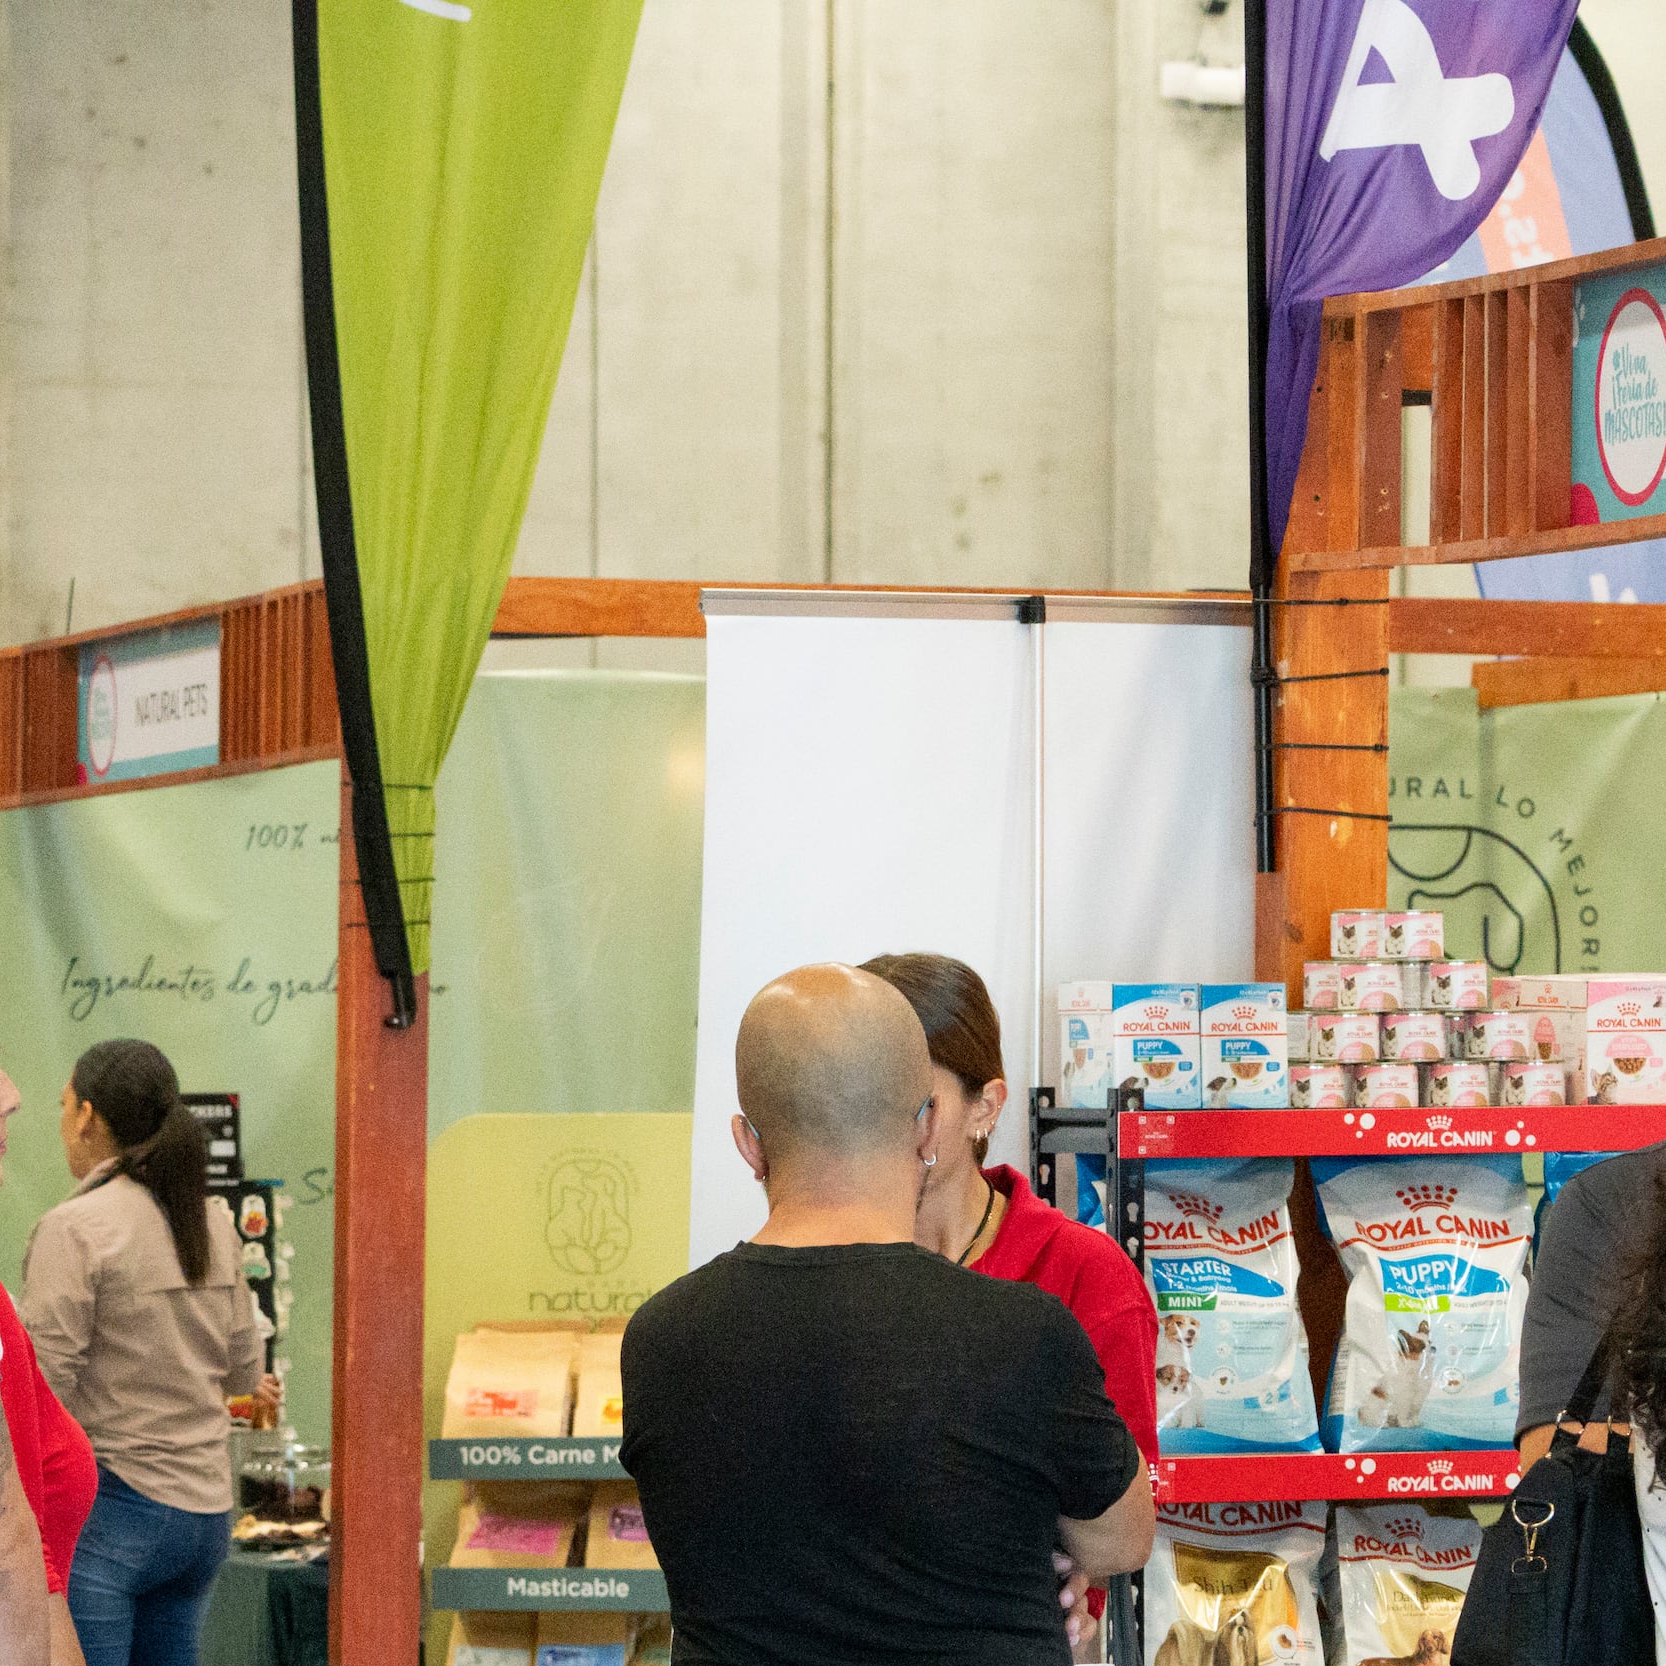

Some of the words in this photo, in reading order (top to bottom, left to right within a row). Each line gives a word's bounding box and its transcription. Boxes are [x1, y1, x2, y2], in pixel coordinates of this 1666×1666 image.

[1123, 1021, 1155, 1032] ROYAL
[1158, 1020, 1191, 1032] CANIN
[1211, 1021, 1244, 1032] ROYAL
[1245, 1020, 1278, 1032] CANIN
[1596, 1017, 1627, 1028] ROYAL
[1629, 1017, 1662, 1028] CANIN
[1386, 1132, 1437, 1148] ROYAL
[1440, 1130, 1493, 1147] CANIN
[1207, 1210, 1280, 1246] CANIN
[1435, 1215, 1511, 1240] CANIN
[1161, 1260, 1233, 1277] STARTER
[1389, 1260, 1458, 1285] PUPPY
[1168, 1296, 1203, 1308] MINI
[459, 1446, 521, 1466] 100%
[527, 1446, 596, 1466] Carne
[1387, 1477, 1438, 1493] ROYAL
[1440, 1475, 1494, 1491] CANIN
[1220, 1502, 1303, 1527] CANIN
[1354, 1534, 1414, 1556] ROYAL
[1415, 1545, 1472, 1565] CANIN
[506, 1577, 630, 1598] Masticable
